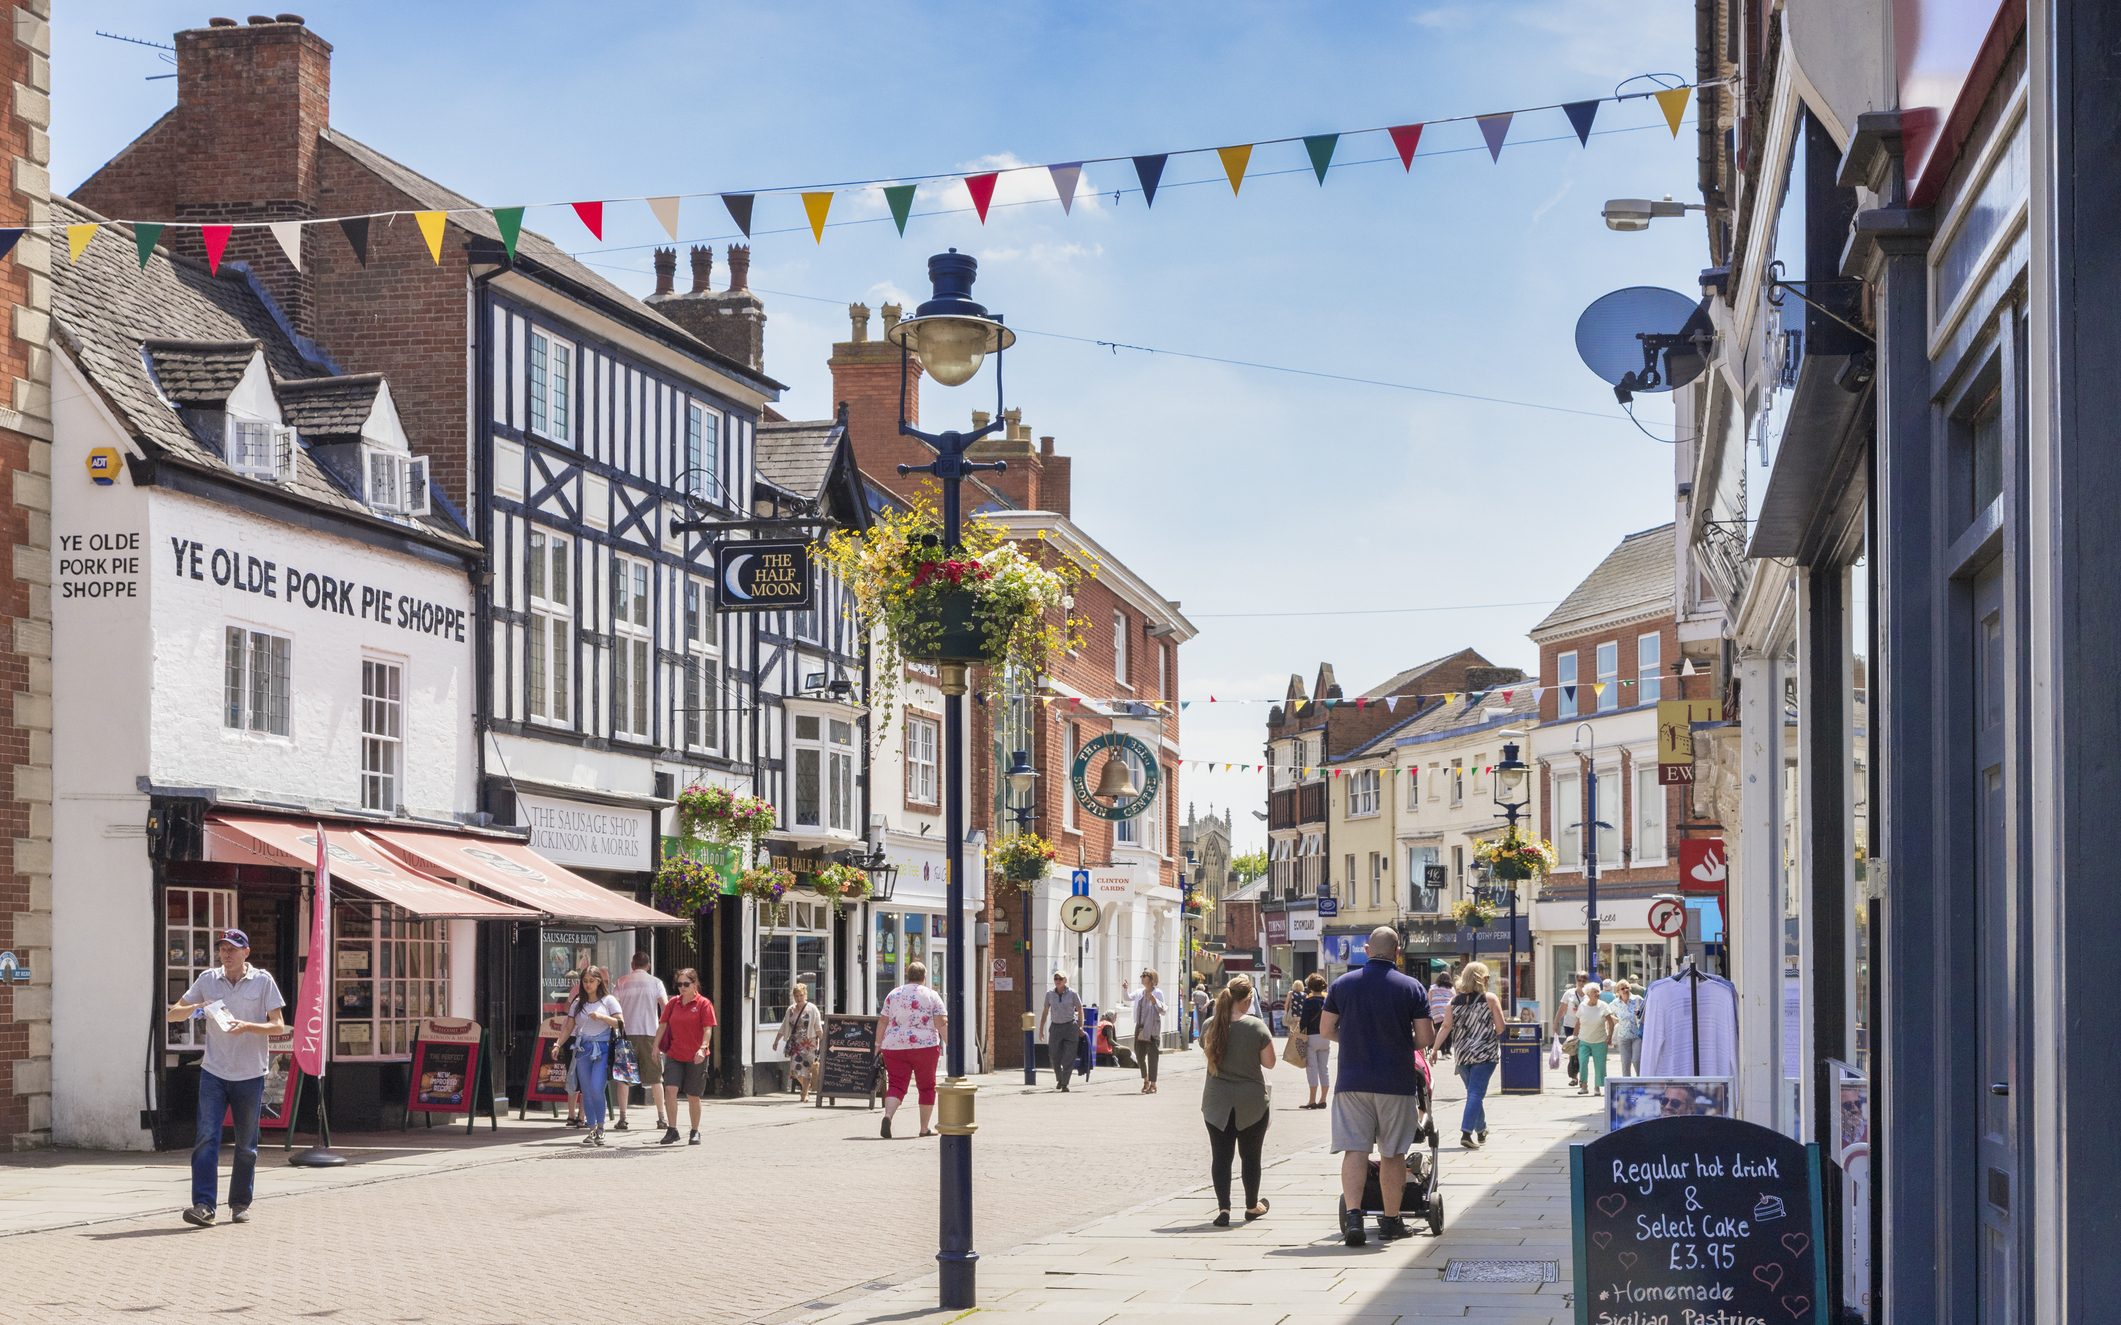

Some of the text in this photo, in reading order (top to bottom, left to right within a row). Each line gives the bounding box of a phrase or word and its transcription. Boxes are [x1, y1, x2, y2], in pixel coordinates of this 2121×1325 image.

[92, 457, 107, 468] ADT
[59, 533, 139, 551] YE OLDE
[60, 557, 139, 575] PORK PIE
[762, 554, 792, 567] THE
[755, 568, 796, 581] HALF
[62, 582, 136, 598] SHOPPE
[171, 536, 465, 643] YE OLDE PORK PIE SHOPPE
[751, 583, 802, 596] MOON
[1073, 776, 1157, 817] SHOPPIN CENTRE
[531, 807, 639, 837] THE SAUSAGE SHOP
[528, 829, 639, 857] DICKINSON & MORRIS
[772, 855, 788, 871] THE
[791, 856, 813, 872] HALF
[1269, 920, 1286, 931] TIMPSON
[542, 932, 597, 945] SAUSAGES & BACON
[1466, 932, 1493, 941] DOOTHY
[542, 977, 571, 988] AVAILABLE
[847, 1040, 871, 1048] GARDEN
[430, 1078, 458, 1086] IMPROVED
[1612, 1153, 1780, 1195] Regular hot drink
[1684, 1185, 1704, 1212] &
[1636, 1213, 1751, 1241] Select Cake
[1669, 1243, 1736, 1271] £3.95
